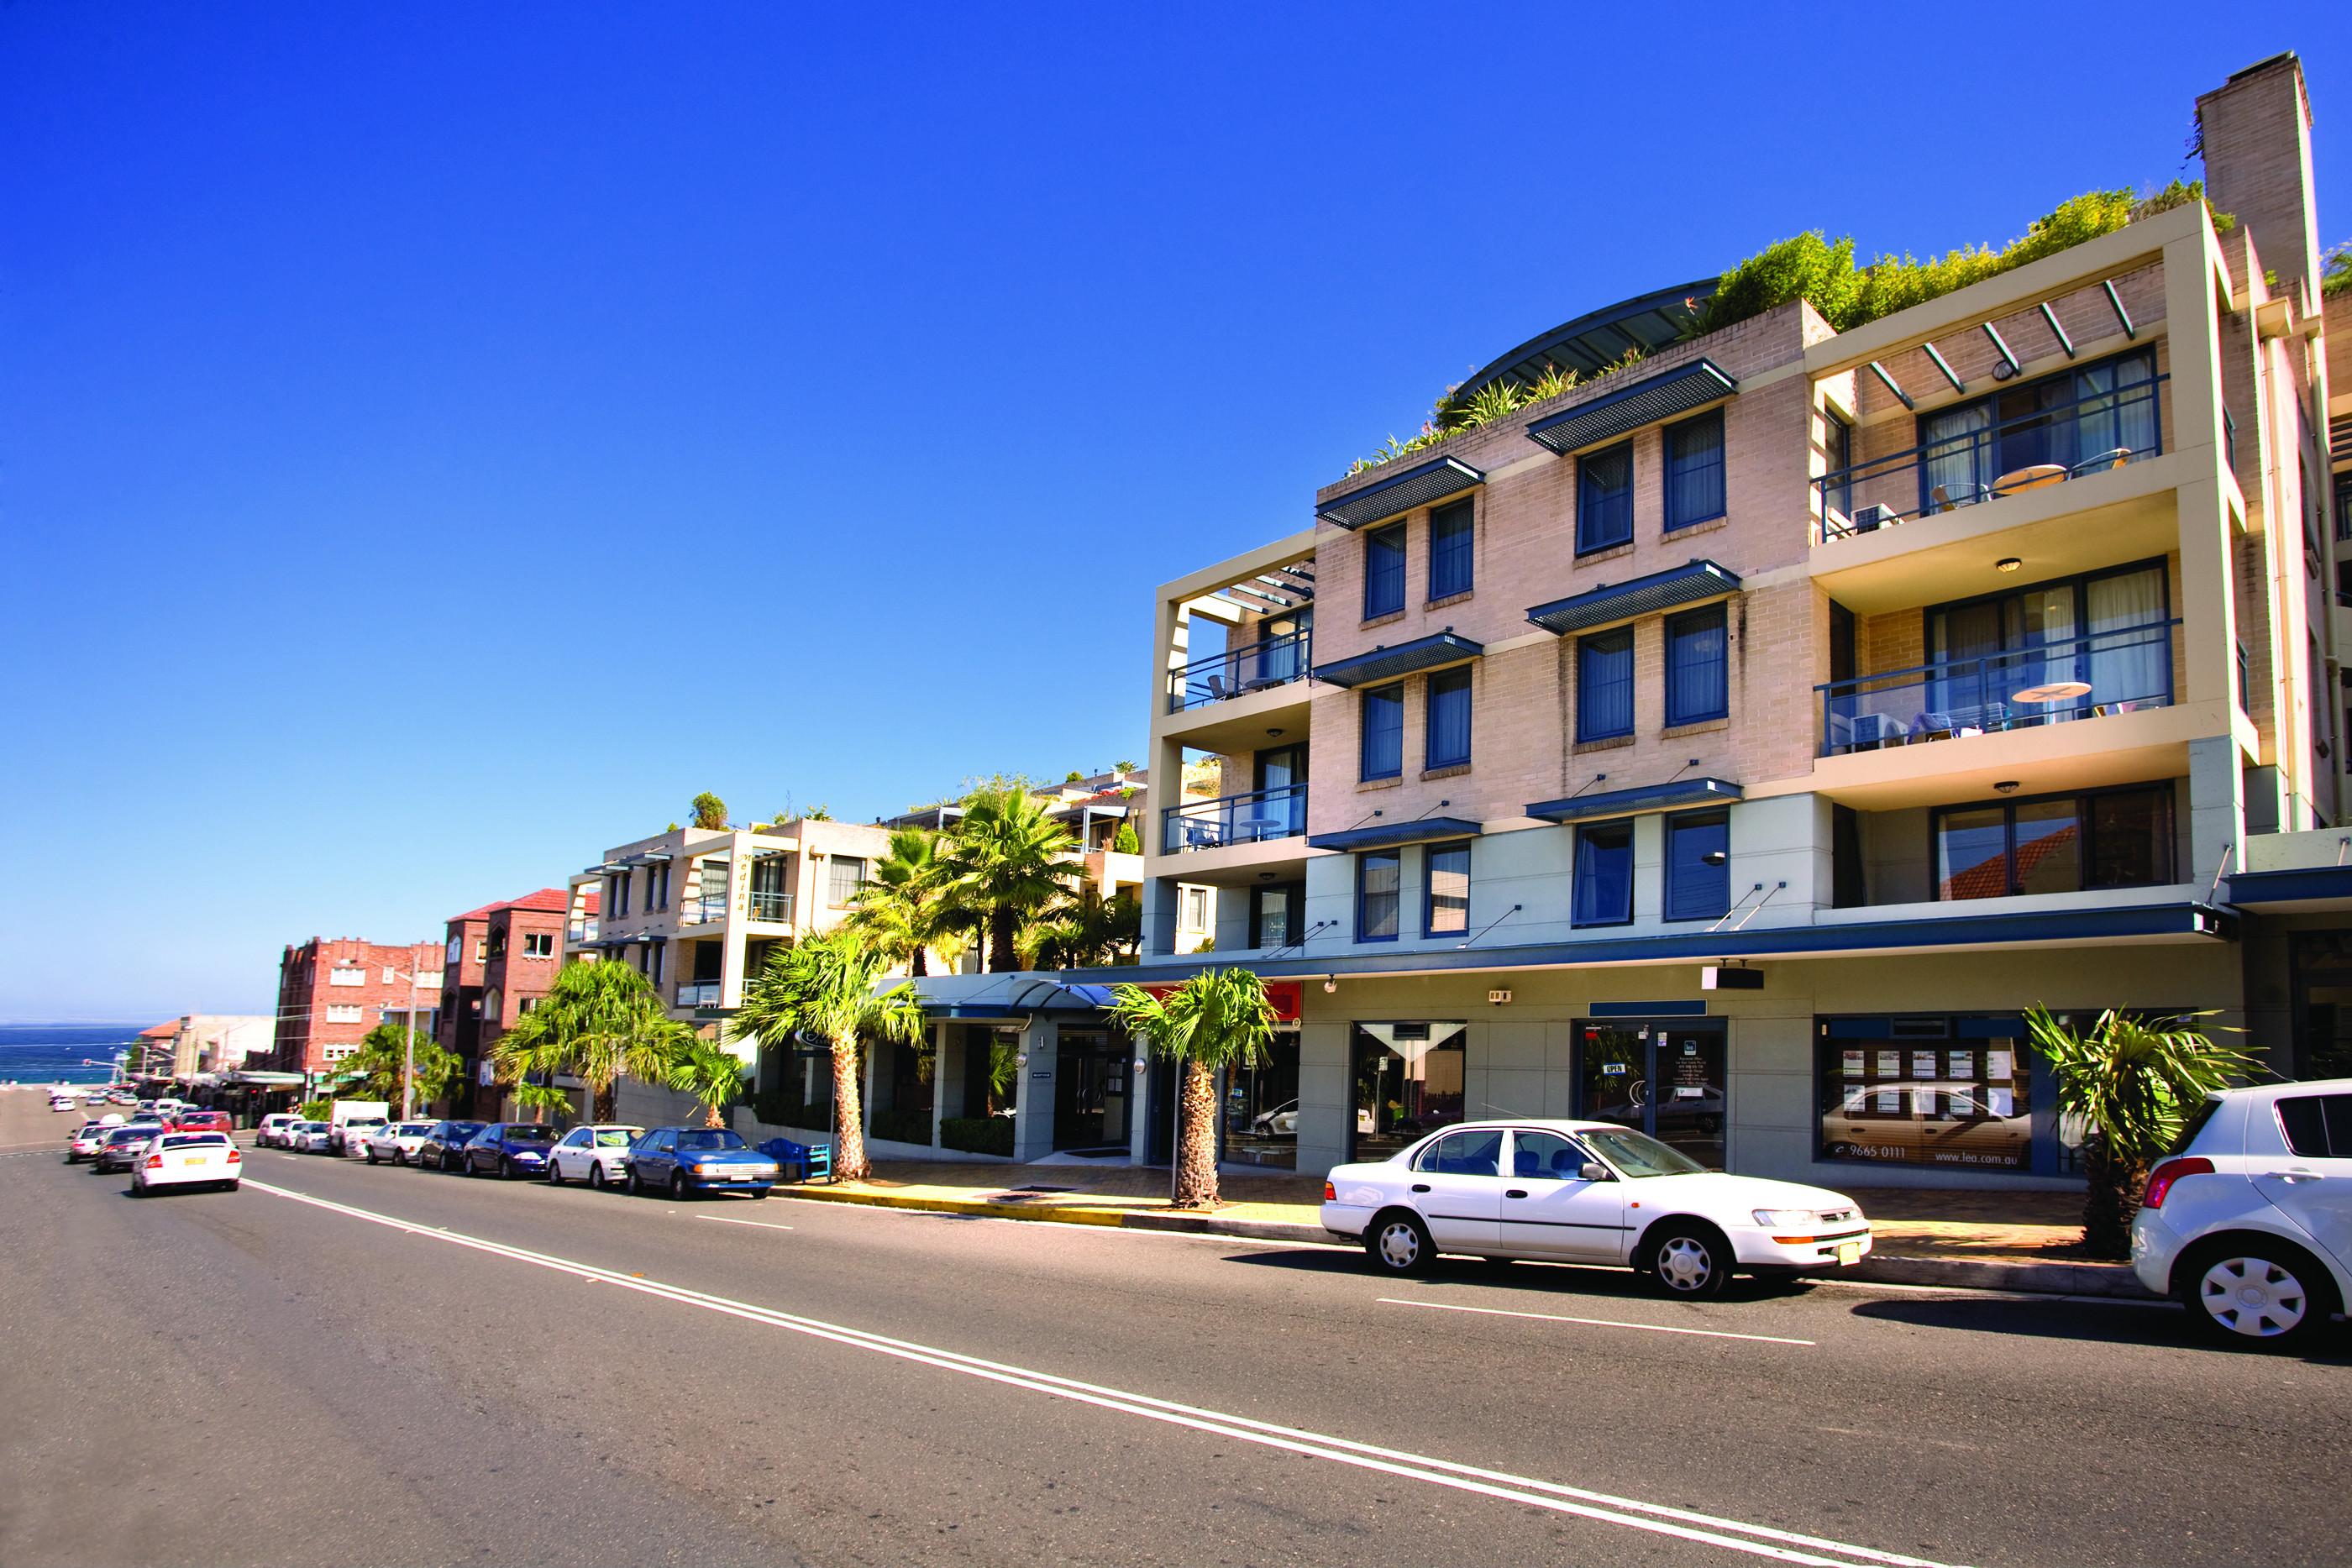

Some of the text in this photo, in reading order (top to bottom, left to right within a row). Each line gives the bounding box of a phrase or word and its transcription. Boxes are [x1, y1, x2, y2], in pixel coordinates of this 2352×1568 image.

[735, 853, 751, 910] Medina
[1606, 1064, 1622, 1073] OPEN
[1850, 1144, 1905, 1158] 9665 0111
[1935, 1151, 2018, 1165] www.lea.com.au
